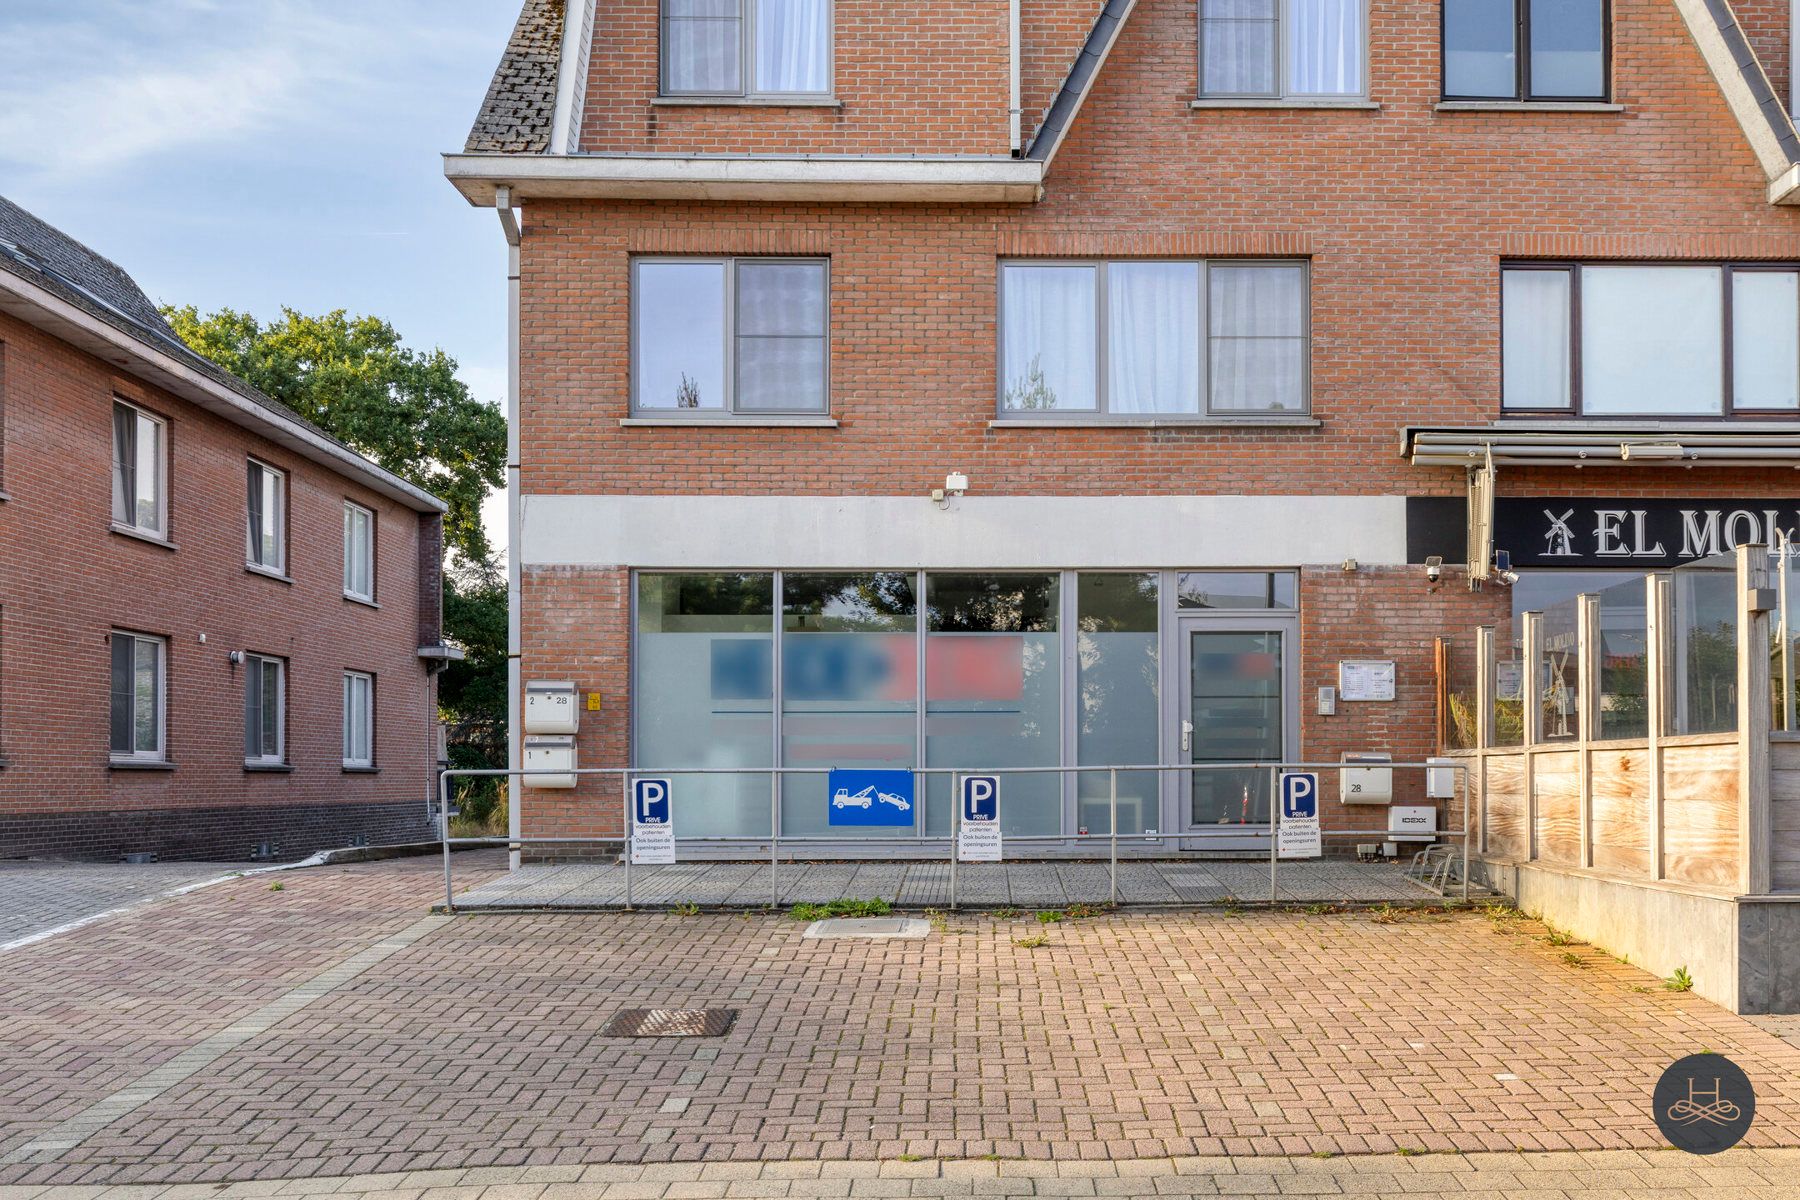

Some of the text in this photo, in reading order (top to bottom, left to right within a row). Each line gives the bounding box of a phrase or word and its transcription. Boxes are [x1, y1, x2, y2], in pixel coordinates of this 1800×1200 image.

[1593, 509, 1800, 558] EL MOL
[530, 696, 535, 705] 2
[642, 782, 664, 816] P
[970, 779, 992, 813] P
[1289, 777, 1311, 811] P
[1351, 784, 1362, 793] 28
